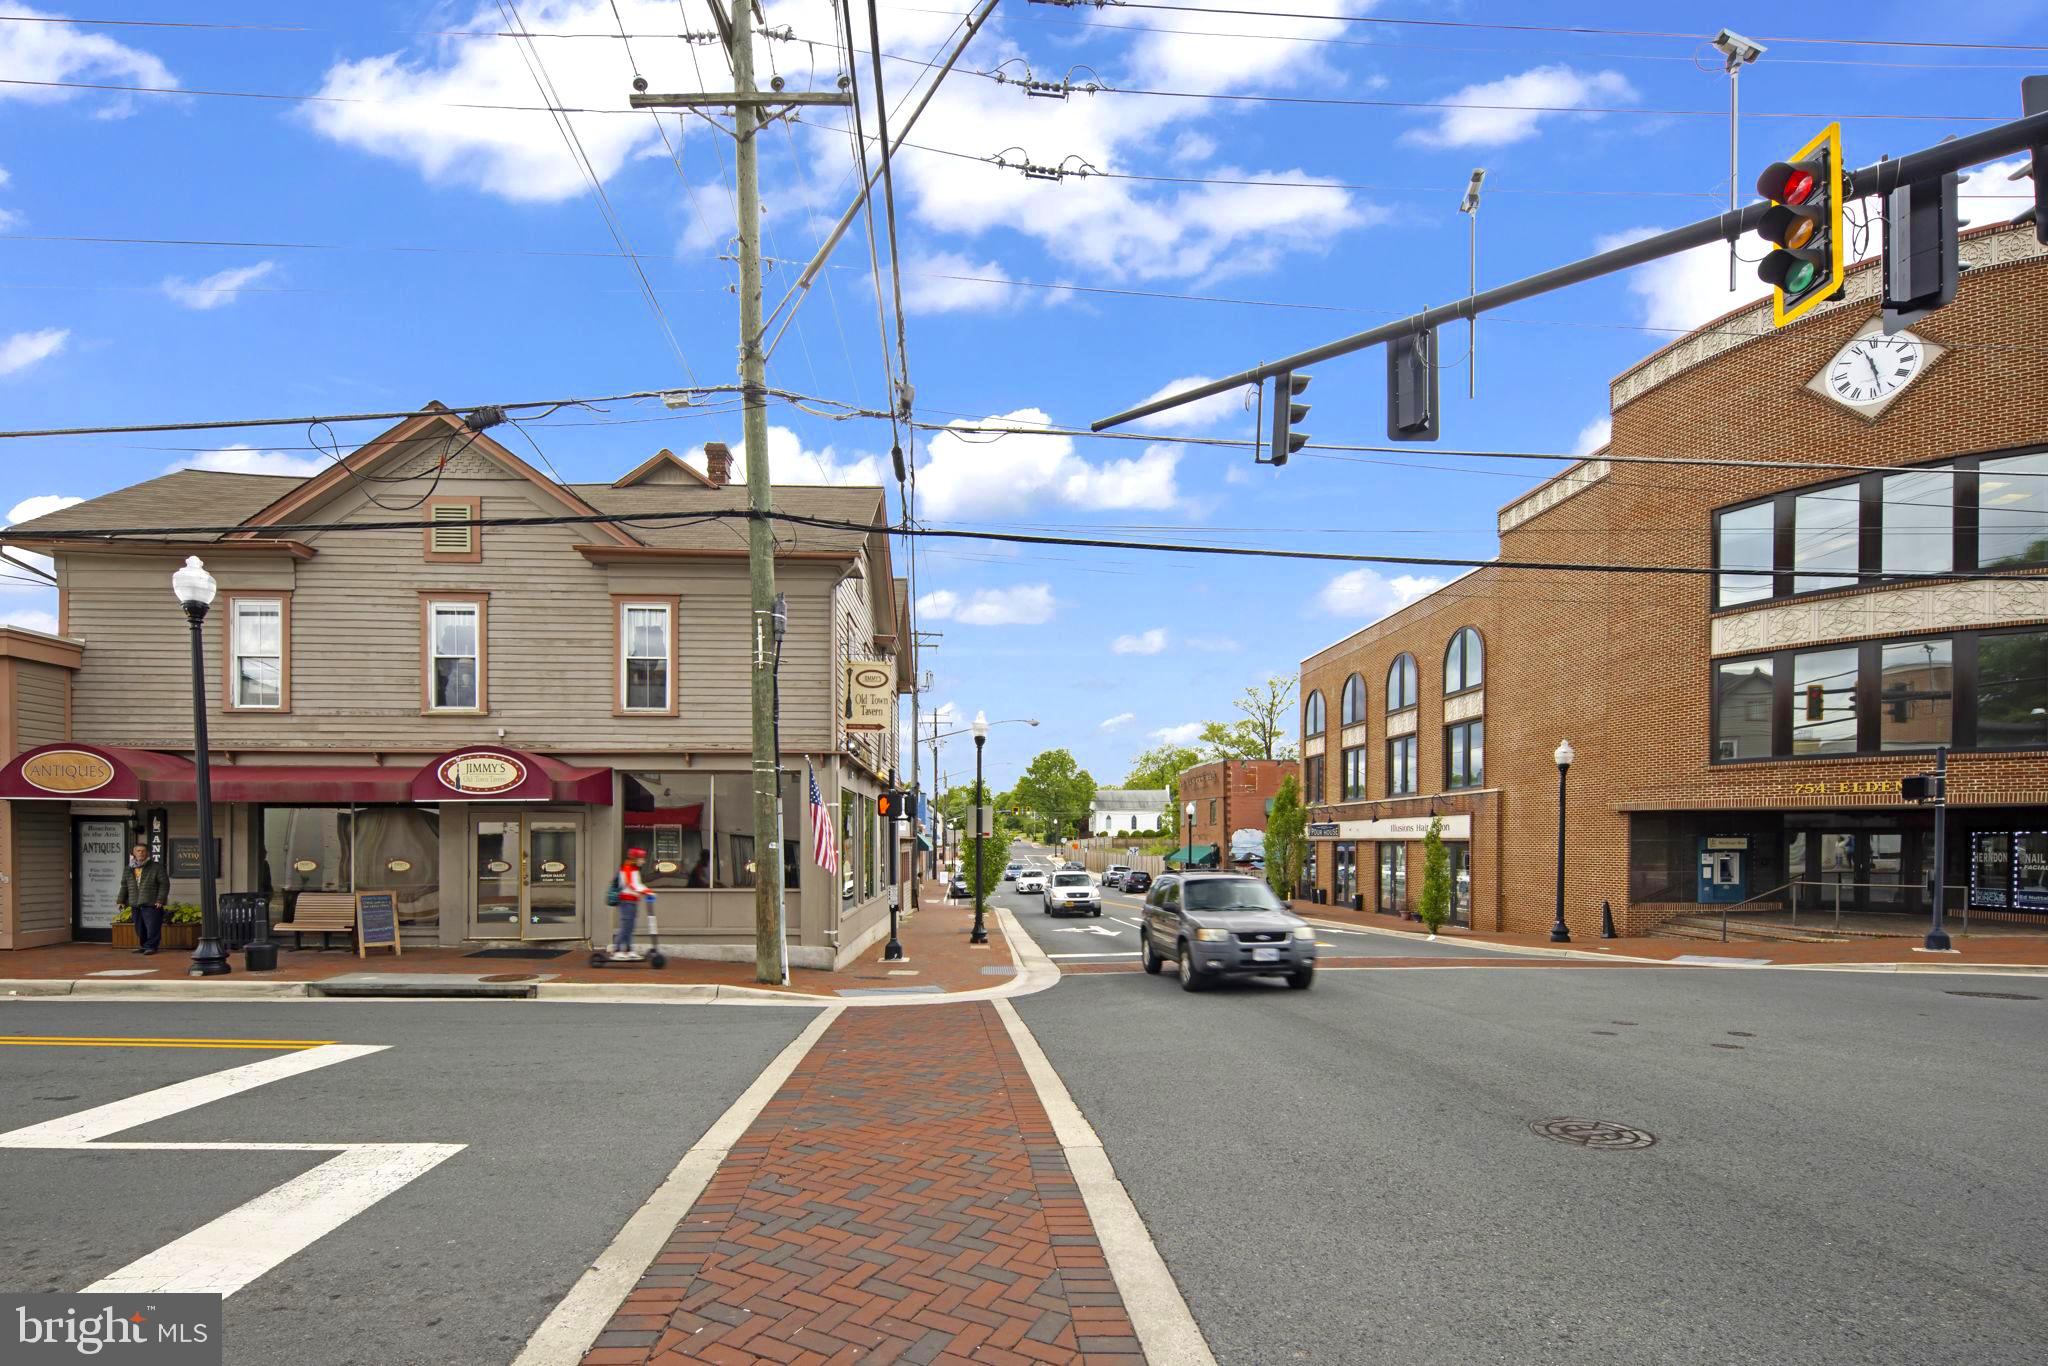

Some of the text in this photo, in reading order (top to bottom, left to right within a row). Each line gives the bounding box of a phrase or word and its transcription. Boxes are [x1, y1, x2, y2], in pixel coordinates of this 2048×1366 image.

[855, 693, 889, 705] Old Town
[860, 705, 883, 716] Tavern
[30, 764, 105, 779] ANTIQUES
[466, 763, 506, 774] JIMMY'S
[1794, 783, 1826, 794] 754
[1390, 824, 1414, 832] Illusions
[1416, 823, 1429, 832] Hair
[83, 842, 121, 855] ANTIQUES
[177, 852, 200, 860] ANTIQ
[1974, 852, 2046, 864] HERNDON NAIL
